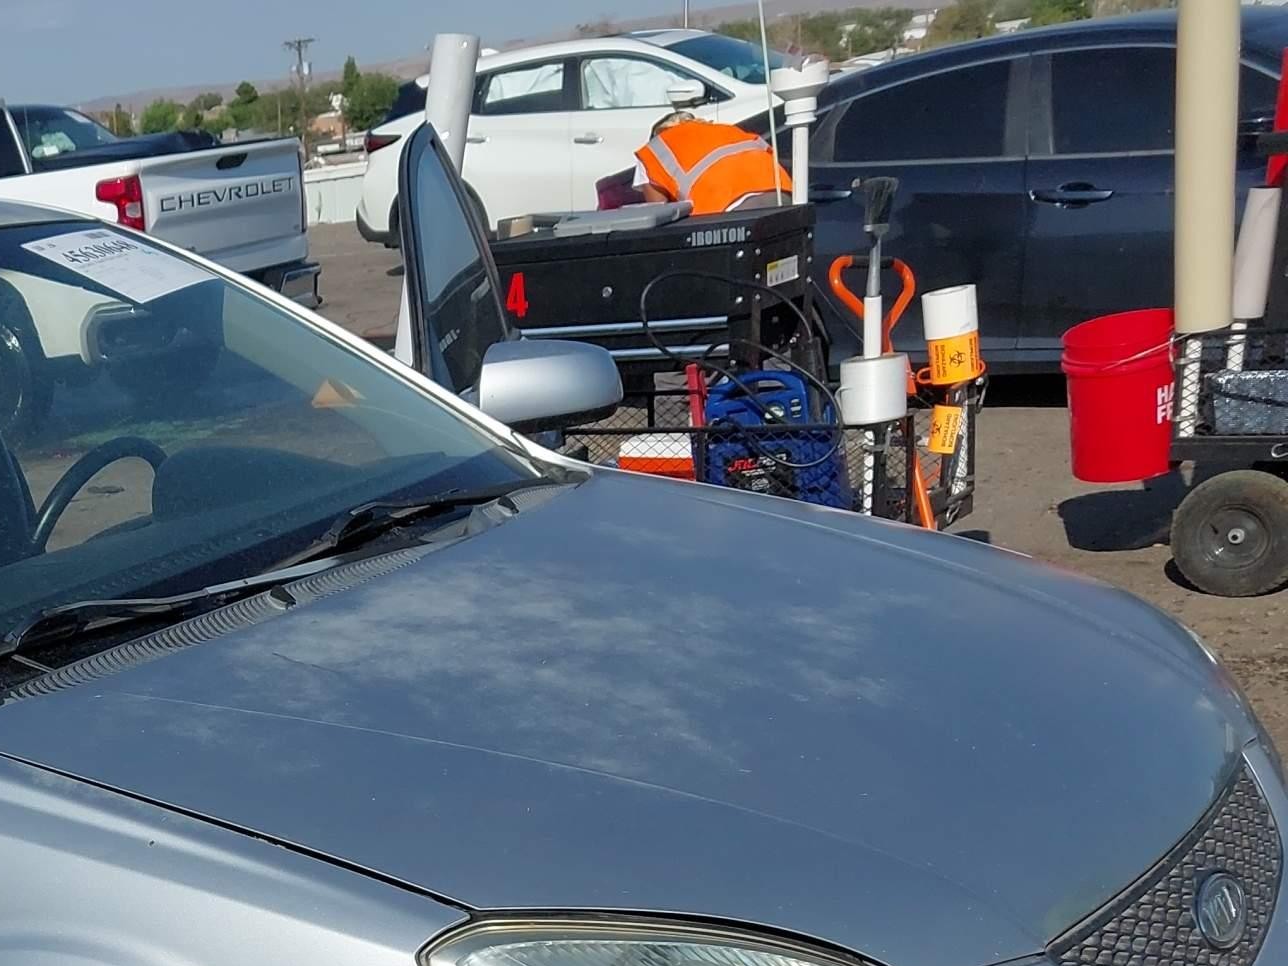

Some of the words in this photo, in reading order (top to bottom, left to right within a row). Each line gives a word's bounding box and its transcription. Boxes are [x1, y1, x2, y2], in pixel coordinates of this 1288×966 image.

[160, 176, 294, 212] CHEVROLET
[691, 226, 746, 247] IRONTON
[61, 240, 138, 265] 45630648
[506, 271, 529, 318] 4
